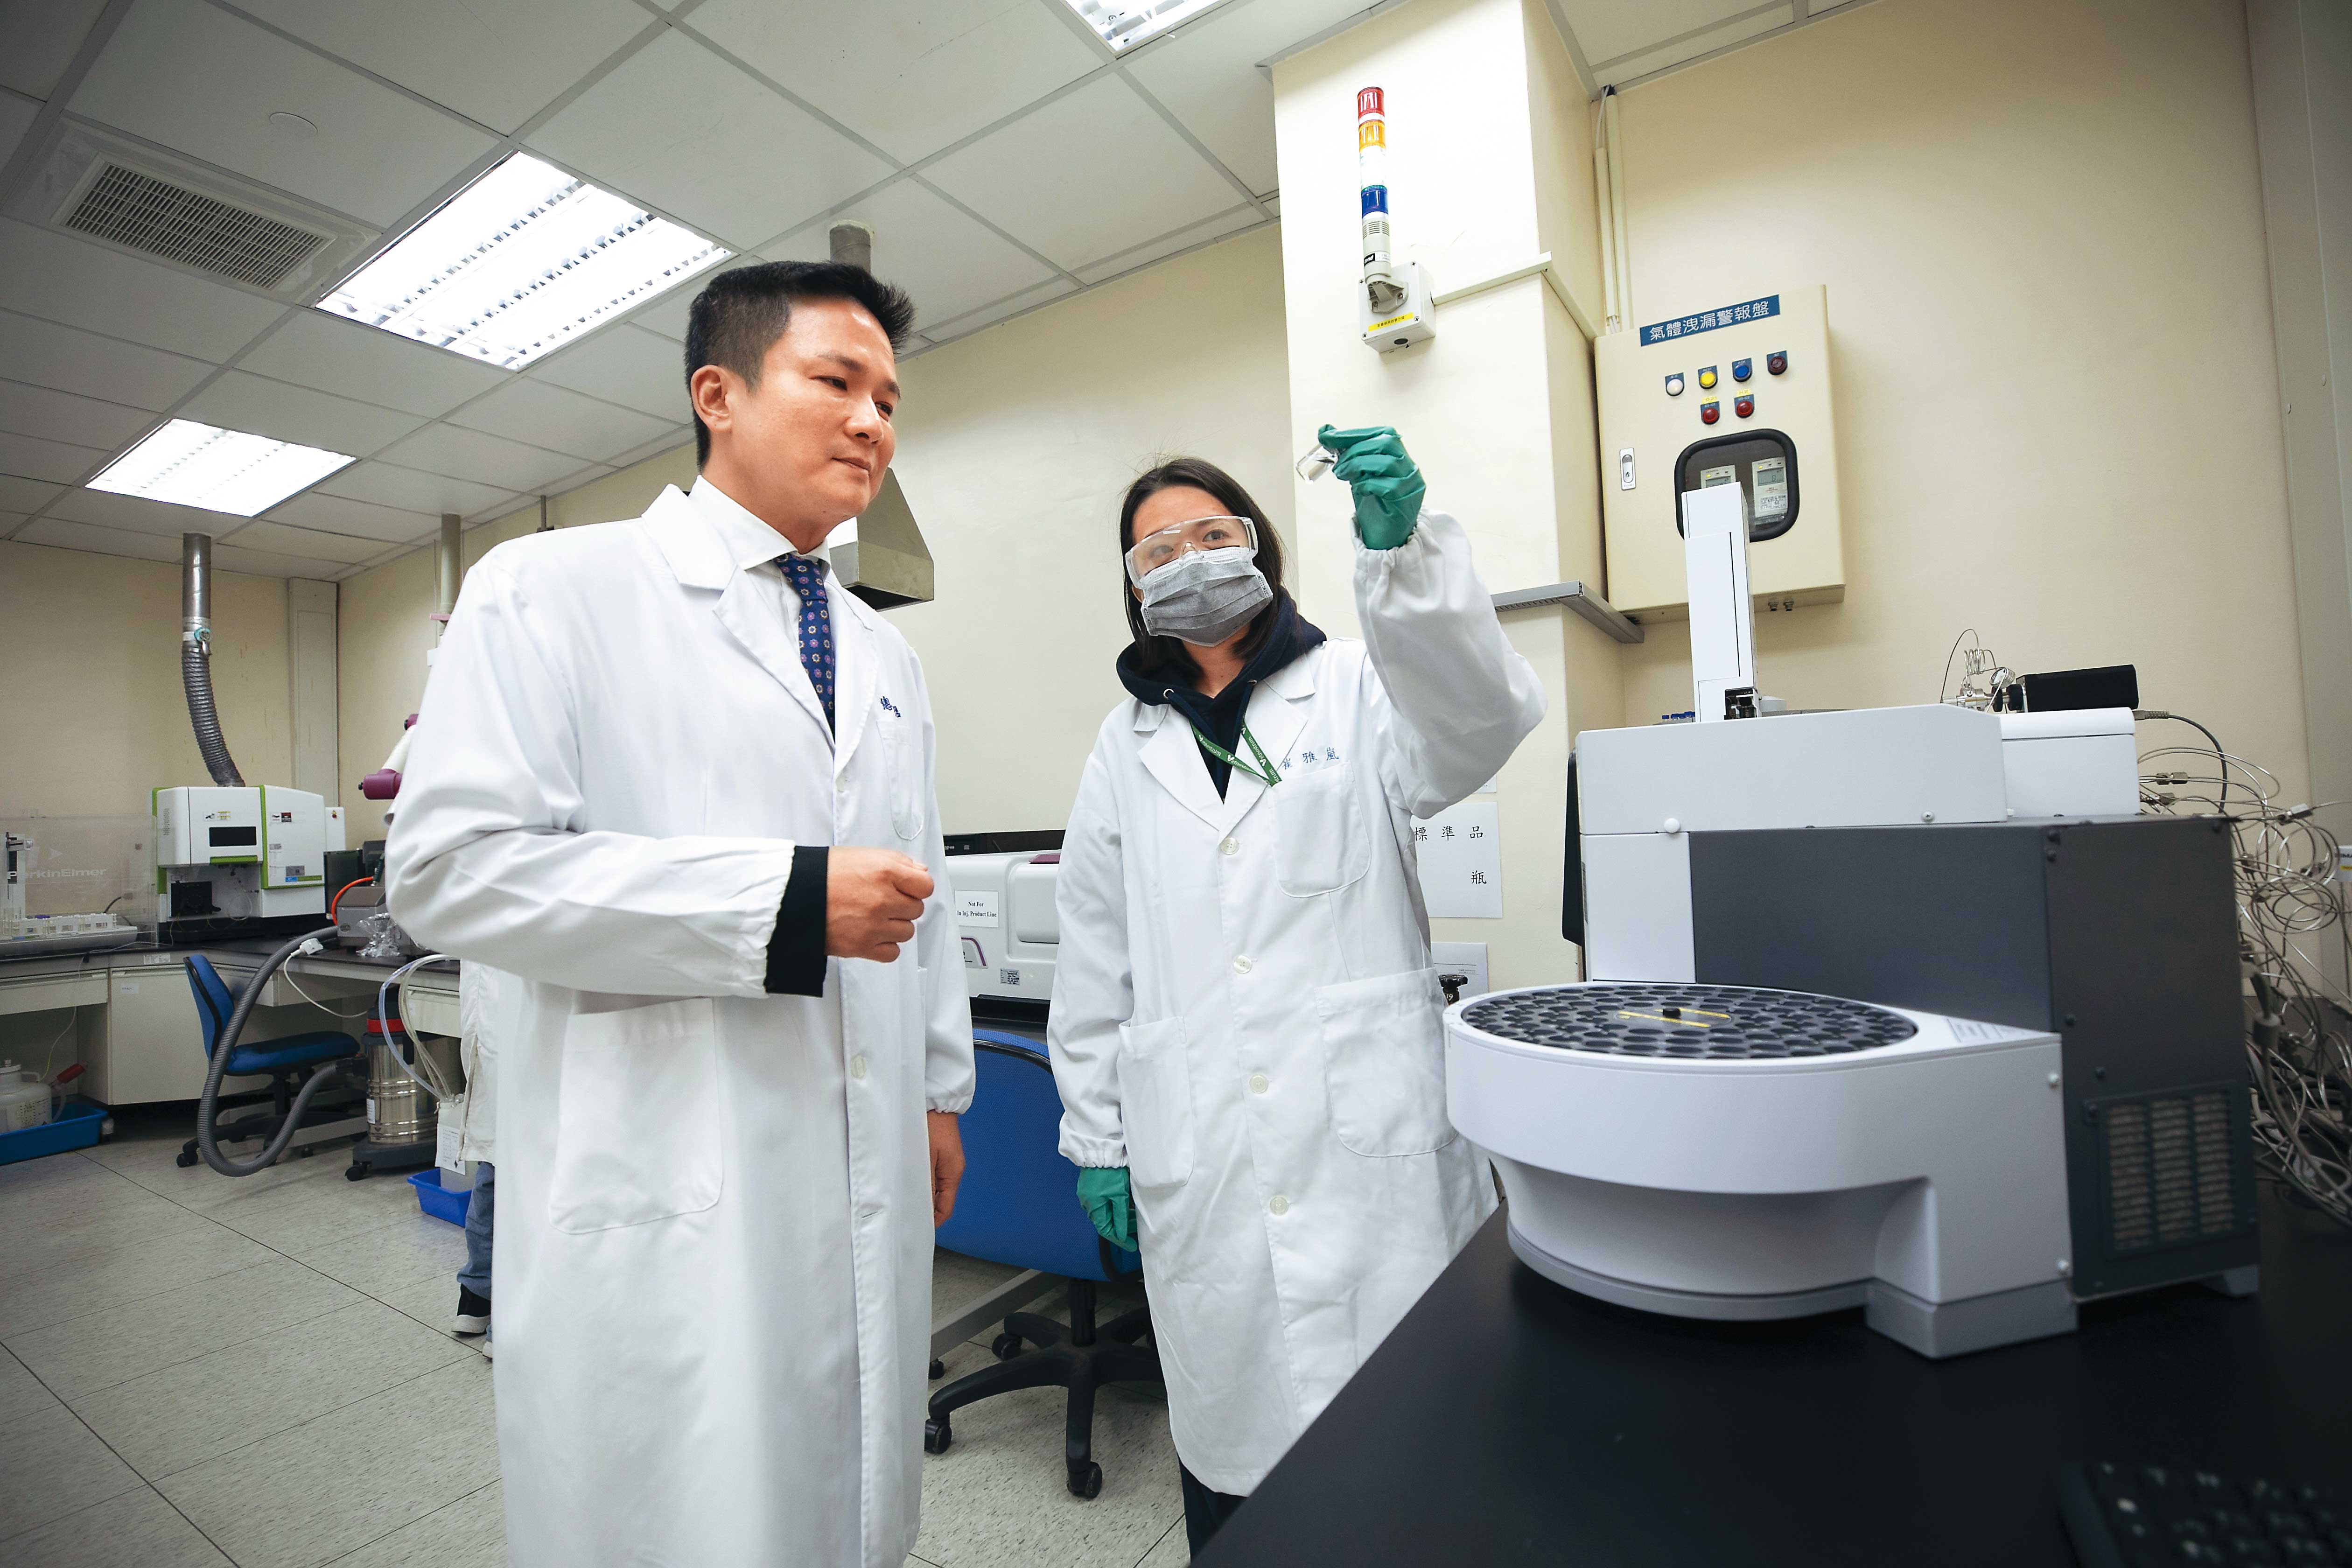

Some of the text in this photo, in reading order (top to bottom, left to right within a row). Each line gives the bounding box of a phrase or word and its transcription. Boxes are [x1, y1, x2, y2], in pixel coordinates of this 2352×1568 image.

[1650, 301, 1769, 340] 氣體洩漏警報盤
[1414, 826, 1483, 841] 標準品
[7, 869, 106, 879] PrkinElmer
[1471, 870, 1487, 884] 瓶
